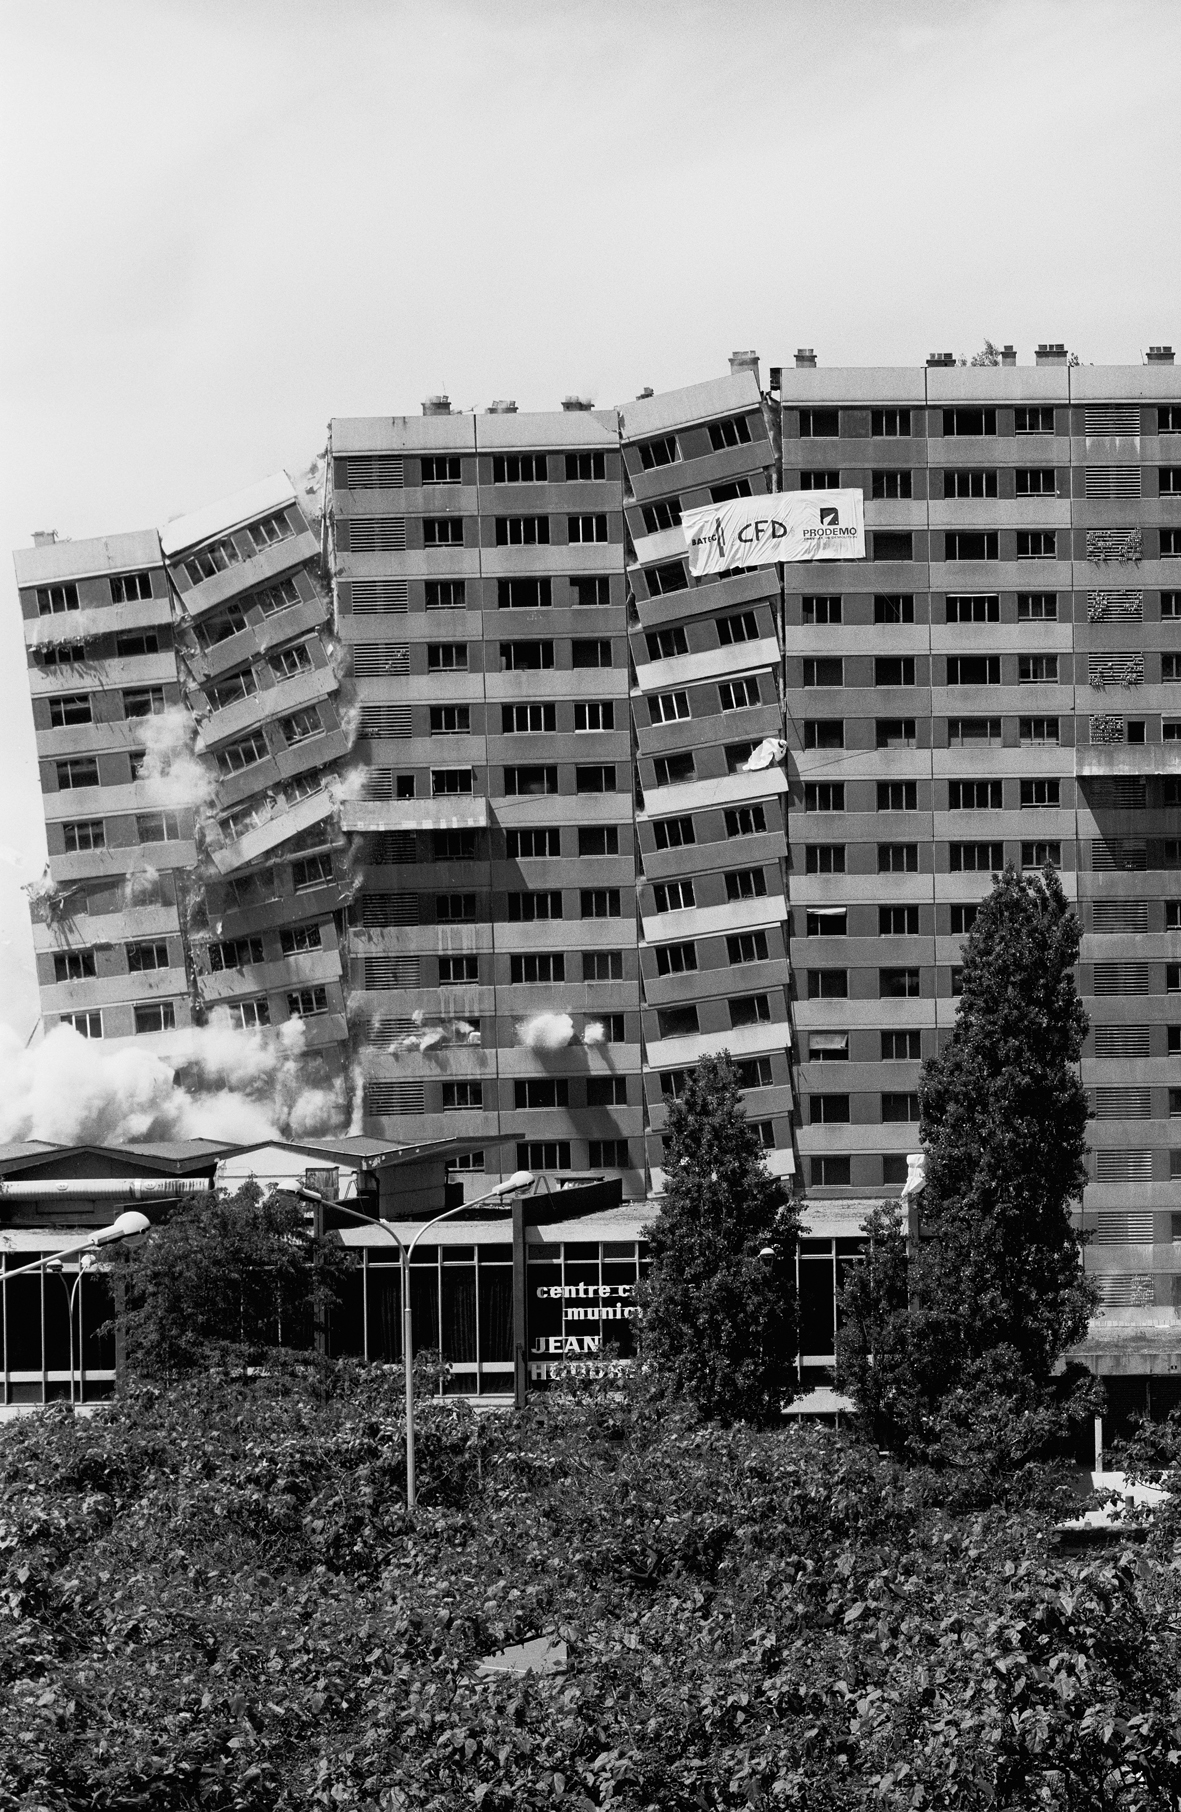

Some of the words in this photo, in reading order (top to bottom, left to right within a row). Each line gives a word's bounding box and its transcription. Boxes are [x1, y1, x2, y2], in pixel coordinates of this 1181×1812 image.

[691, 534, 717, 546] BATEG
[737, 519, 788, 543] CFD
[802, 526, 858, 537] PRODEMO
[536, 1281, 611, 1299] centre
[530, 1336, 599, 1354] JEAN
